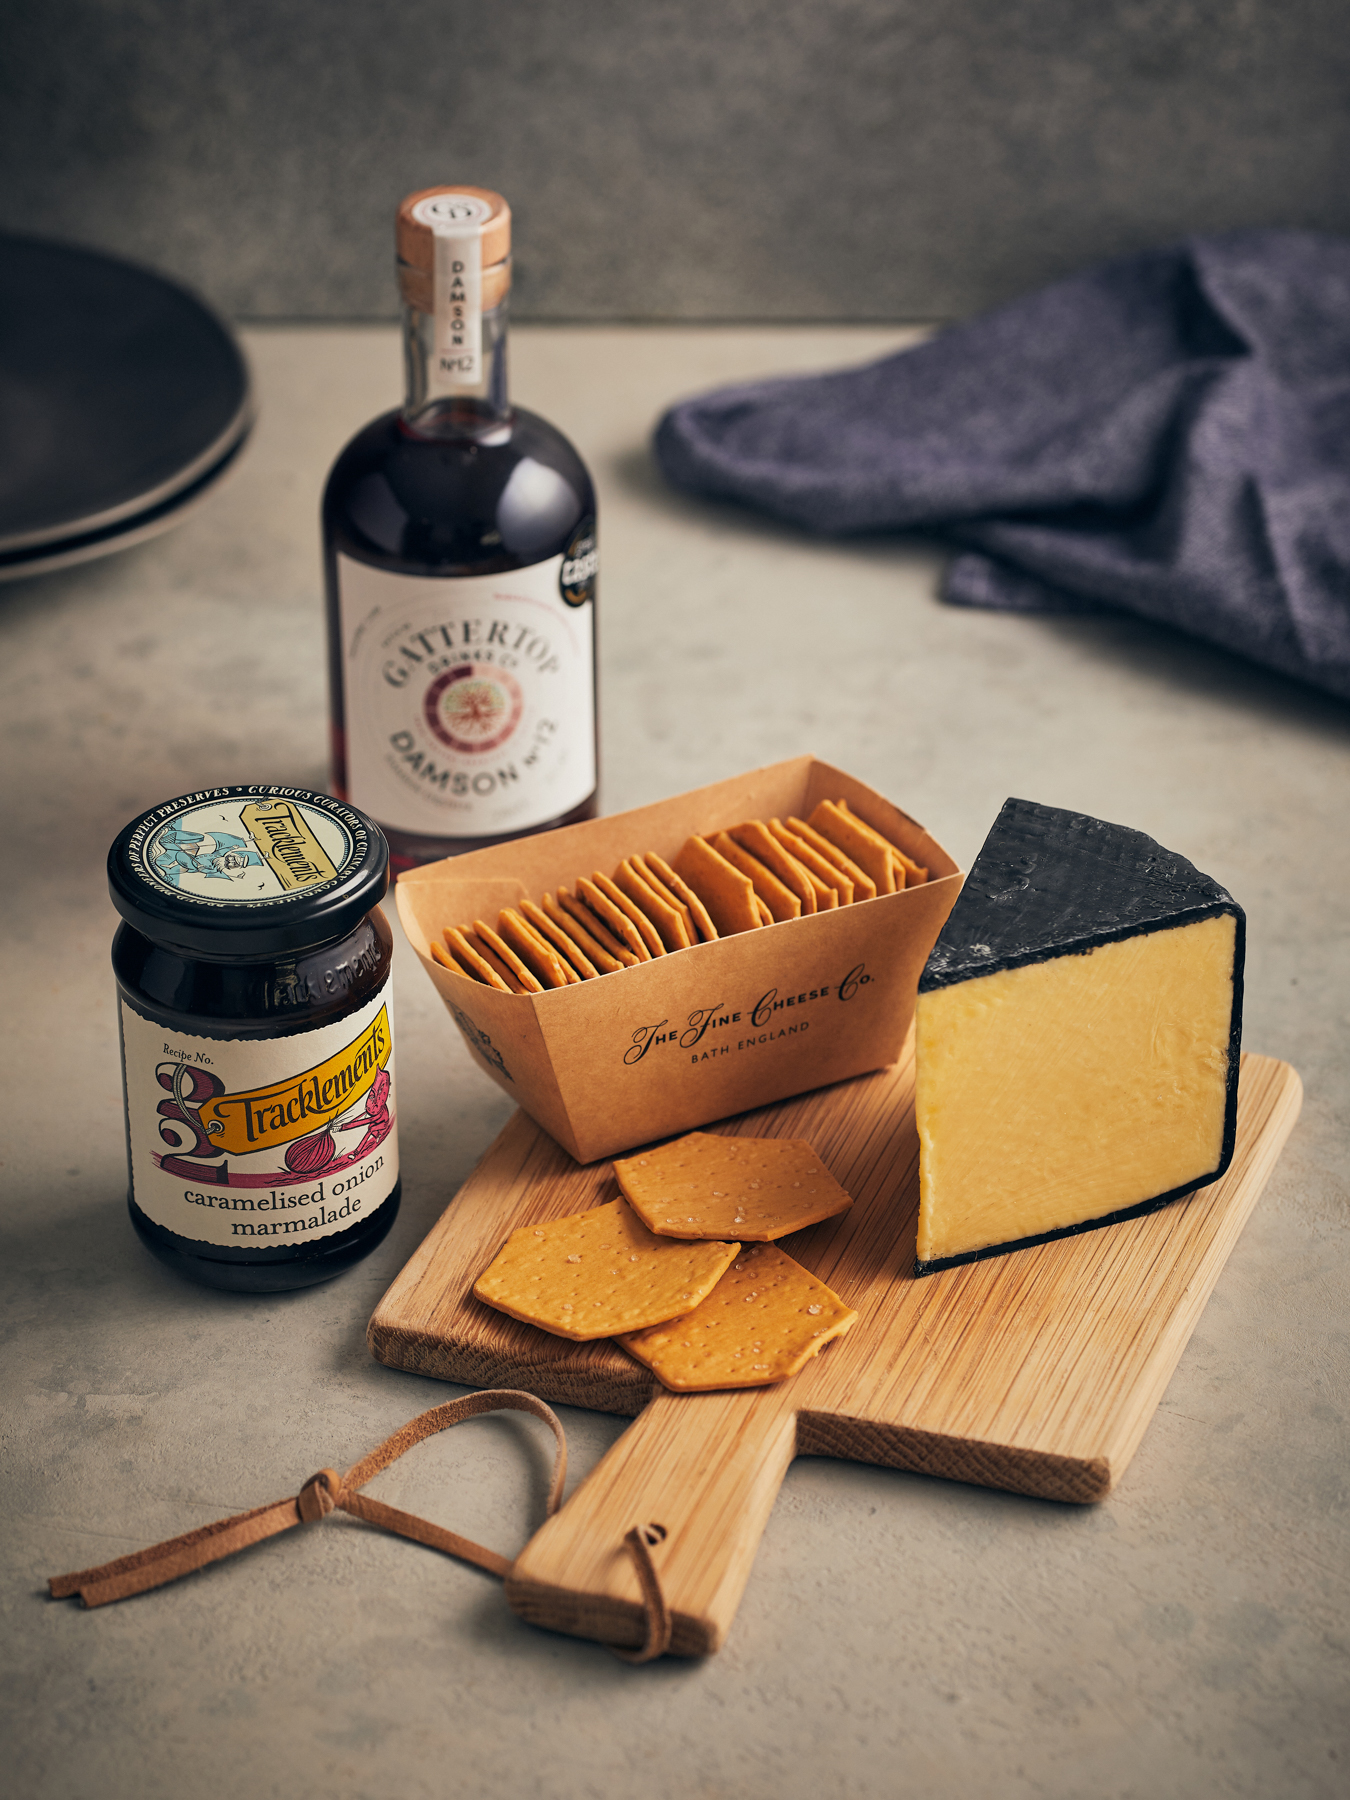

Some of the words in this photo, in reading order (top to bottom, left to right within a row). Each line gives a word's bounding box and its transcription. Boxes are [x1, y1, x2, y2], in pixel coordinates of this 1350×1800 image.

[449, 260, 466, 346] DAMSON
[381, 619, 560, 688] GATTERTOP
[389, 729, 518, 797] DAMSON
[156, 787, 230, 818] PRESERVES
[248, 785, 312, 800] CURIOUS
[129, 813, 158, 851] PERFECT
[313, 795, 363, 830] CURATORS
[254, 802, 329, 882] Tracklements
[354, 830, 368, 841] OF
[128, 851, 141, 862] OF
[339, 841, 368, 881] CULINARY
[163, 1043, 192, 1062] Recipe
[193, 1052, 214, 1065] No.
[691, 1045, 730, 1064] BATH
[738, 1021, 810, 1050] ENGLAND
[213, 1017, 386, 1142] Tracklements
[184, 1181, 325, 1212] caramelised
[332, 1155, 384, 1196] onion
[231, 1197, 362, 1236] marmalade
